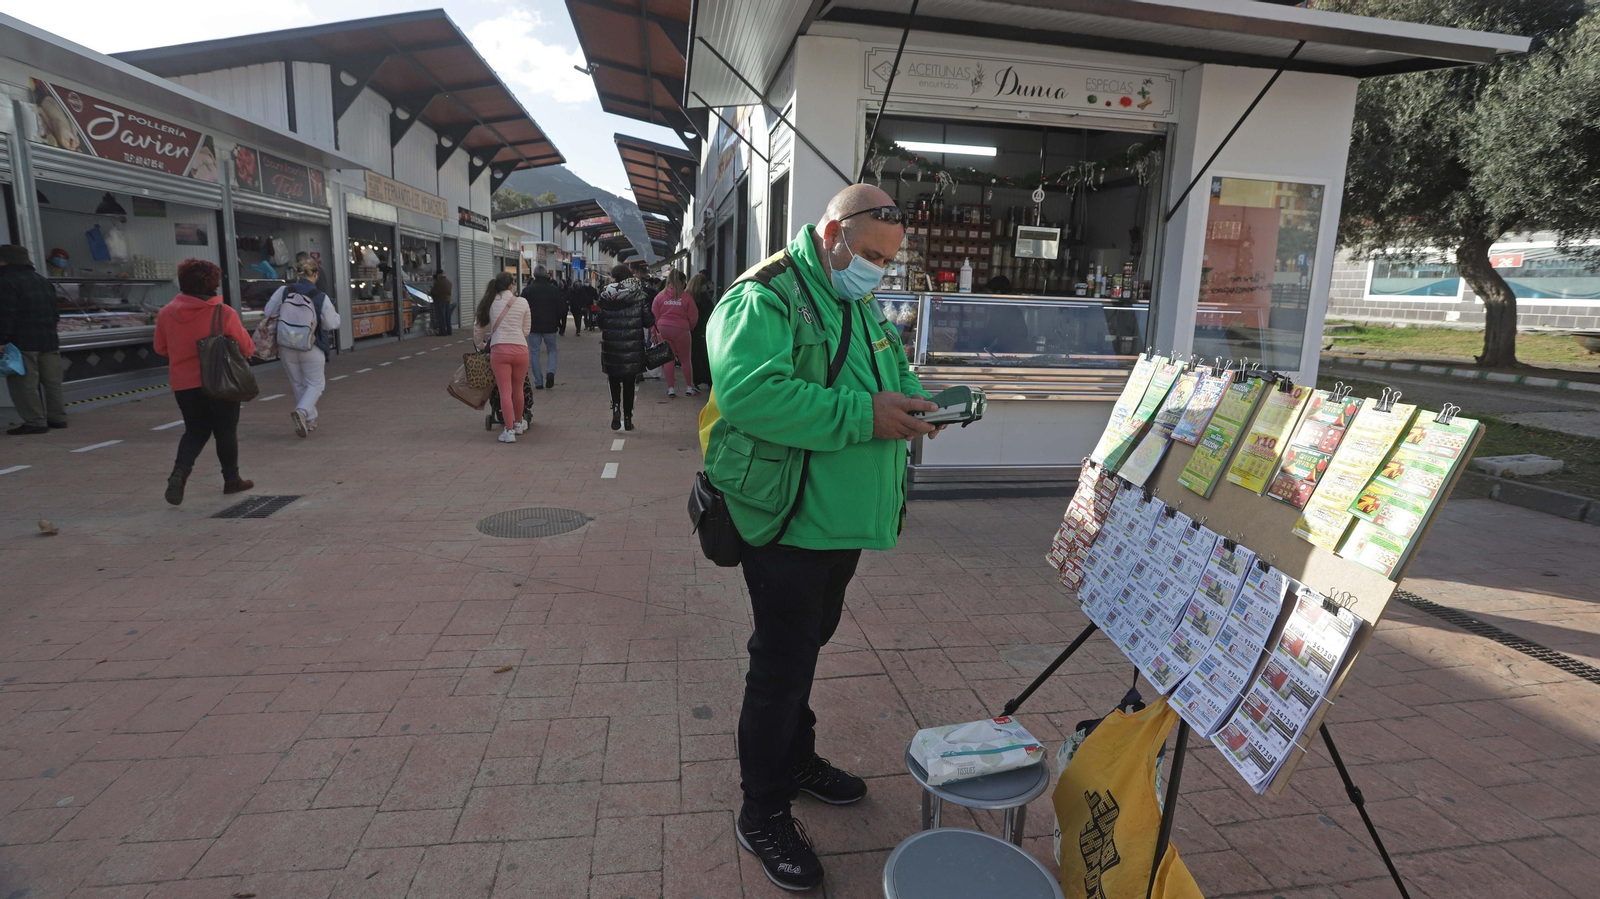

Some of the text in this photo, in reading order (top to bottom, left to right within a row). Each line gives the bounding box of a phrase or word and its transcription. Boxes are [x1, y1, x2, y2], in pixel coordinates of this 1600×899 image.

[908, 62, 971, 79] ACEITUNAS
[919, 80, 959, 90] encurtidos
[994, 65, 1069, 100] Dunia
[1085, 77, 1133, 93] ESPECIAS
[87, 104, 189, 158] Javier
[127, 114, 187, 139] POLLERÍA
[1259, 606, 1275, 620] 93620
[1244, 638, 1260, 653] 93620
[1312, 641, 1332, 659] 54730
[1227, 669, 1244, 685] 93620
[1206, 698, 1222, 715] 93620
[1275, 708, 1294, 728] 54730
[1254, 740, 1273, 760] 54730
[957, 766, 976, 776] TISSUES
[777, 862, 802, 874] FILA
